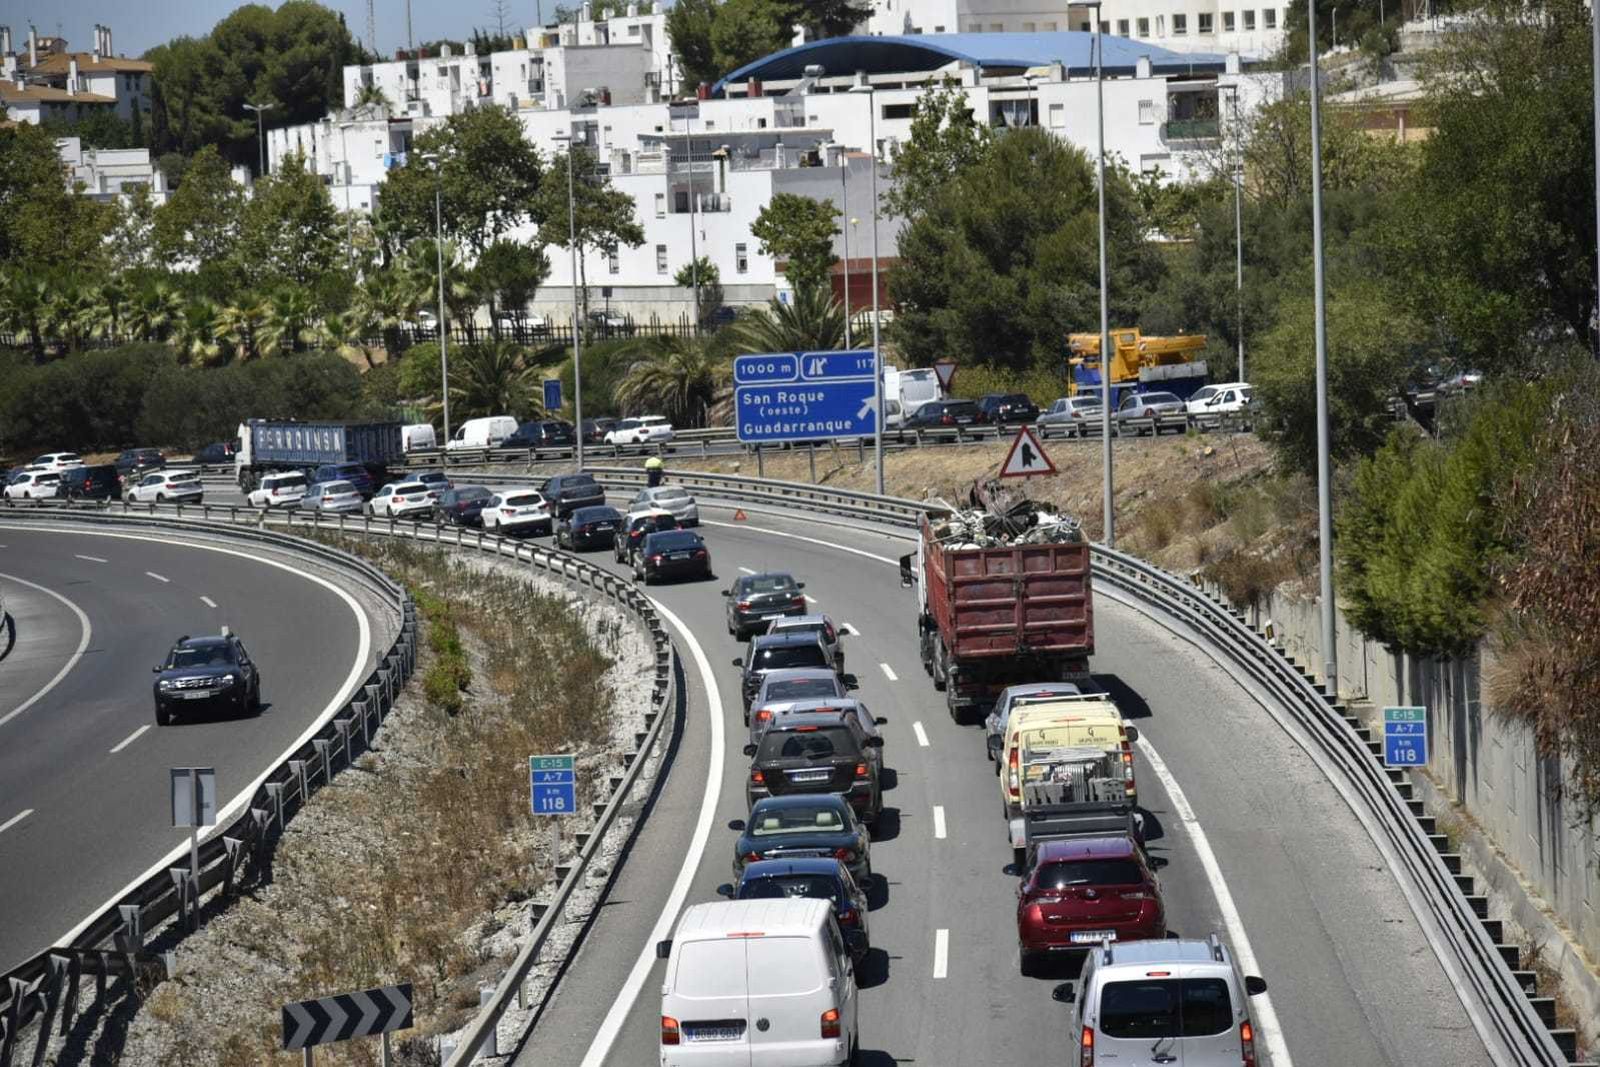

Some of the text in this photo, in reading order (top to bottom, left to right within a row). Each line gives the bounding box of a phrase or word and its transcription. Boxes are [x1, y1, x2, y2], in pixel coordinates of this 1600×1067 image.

[740, 363, 791, 375] 1000 m
[856, 359, 875, 369] 117
[743, 391, 825, 405] San Roque
[759, 405, 808, 417] (oeste)
[744, 419, 852, 435] Guadarranque
[1392, 710, 1415, 720] E-15
[1395, 724, 1414, 733] A-7
[1394, 749, 1416, 762] 118
[540, 758, 563, 768] E-15
[543, 772, 562, 781] A-7
[542, 797, 565, 810] 118
